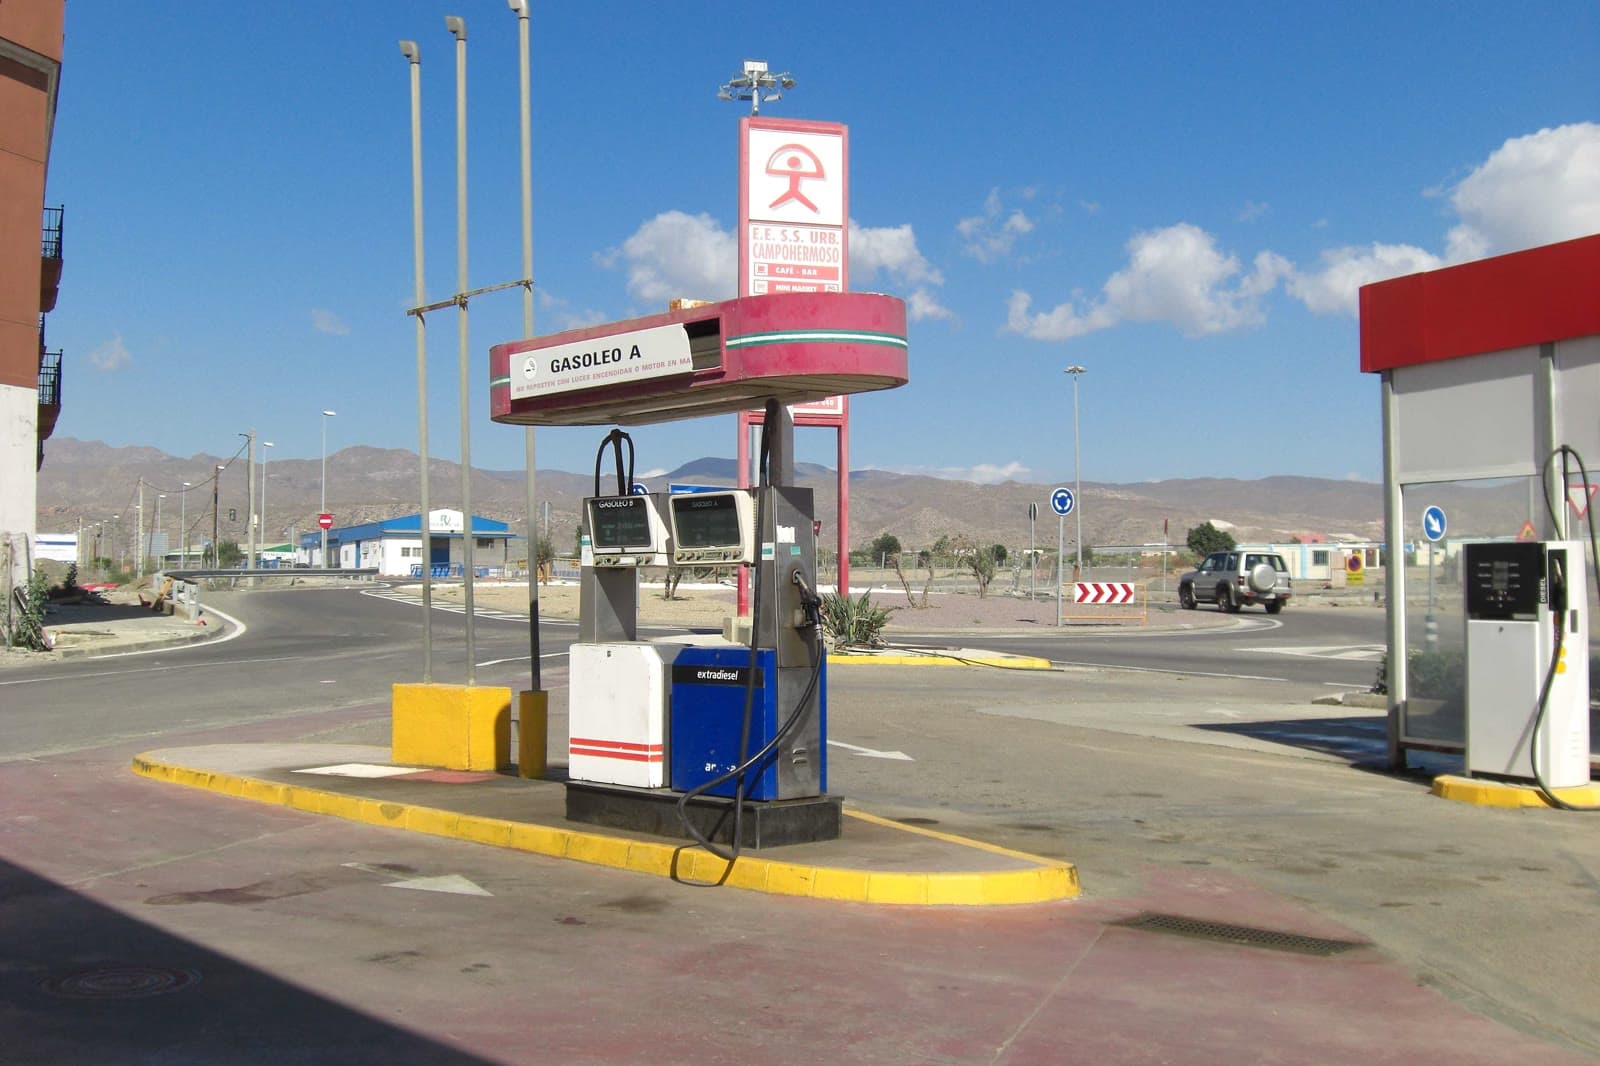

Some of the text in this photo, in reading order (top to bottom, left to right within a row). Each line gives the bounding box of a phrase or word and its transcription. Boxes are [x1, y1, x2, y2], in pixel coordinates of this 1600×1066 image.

[810, 231, 839, 245] URB.
[752, 242, 839, 263] CAMPOHERMOSO
[550, 344, 642, 373] GASOLEO A
[557, 377, 570, 386] CON
[571, 373, 591, 383] LUCES
[592, 367, 633, 380] ENCENDIDAS
[641, 361, 665, 371] MOTOR
[667, 359, 677, 367] EN
[599, 500, 628, 508] GASOLEO
[697, 669, 739, 681] extradiesel
